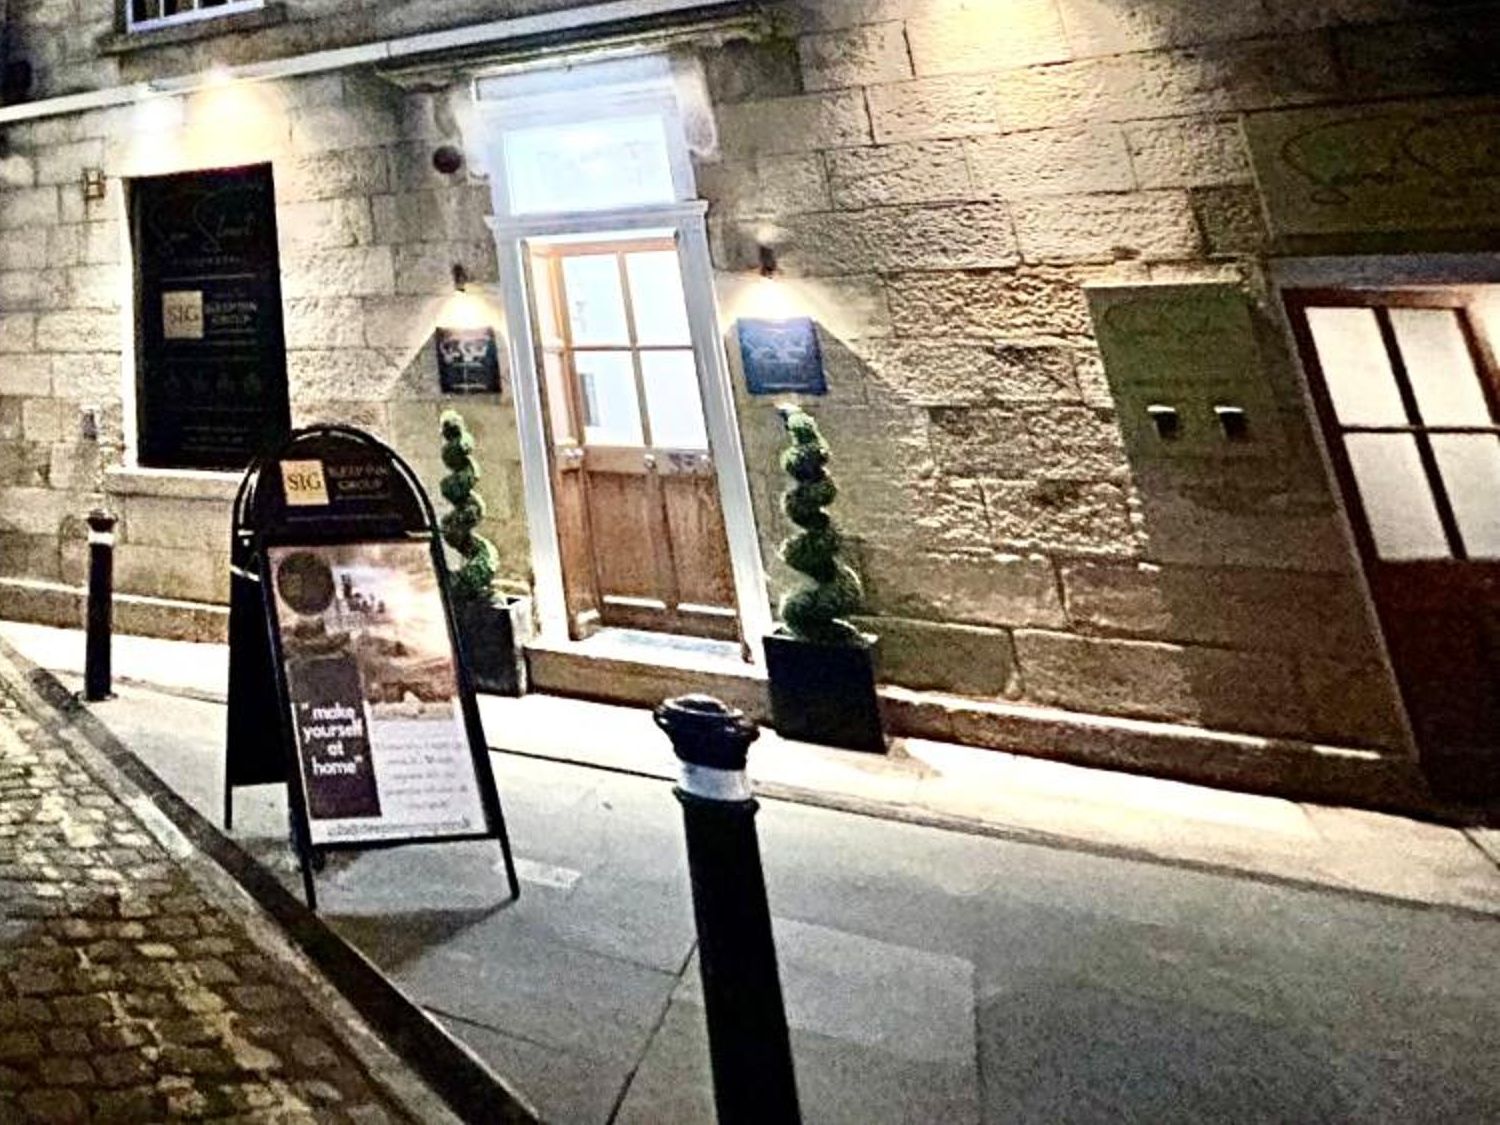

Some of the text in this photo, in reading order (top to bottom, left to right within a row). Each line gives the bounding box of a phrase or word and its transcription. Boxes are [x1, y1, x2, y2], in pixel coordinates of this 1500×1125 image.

[168, 305, 198, 324] SIG
[288, 473, 321, 491] SIG
[303, 719, 363, 742] yourself
[327, 741, 345, 756] at
